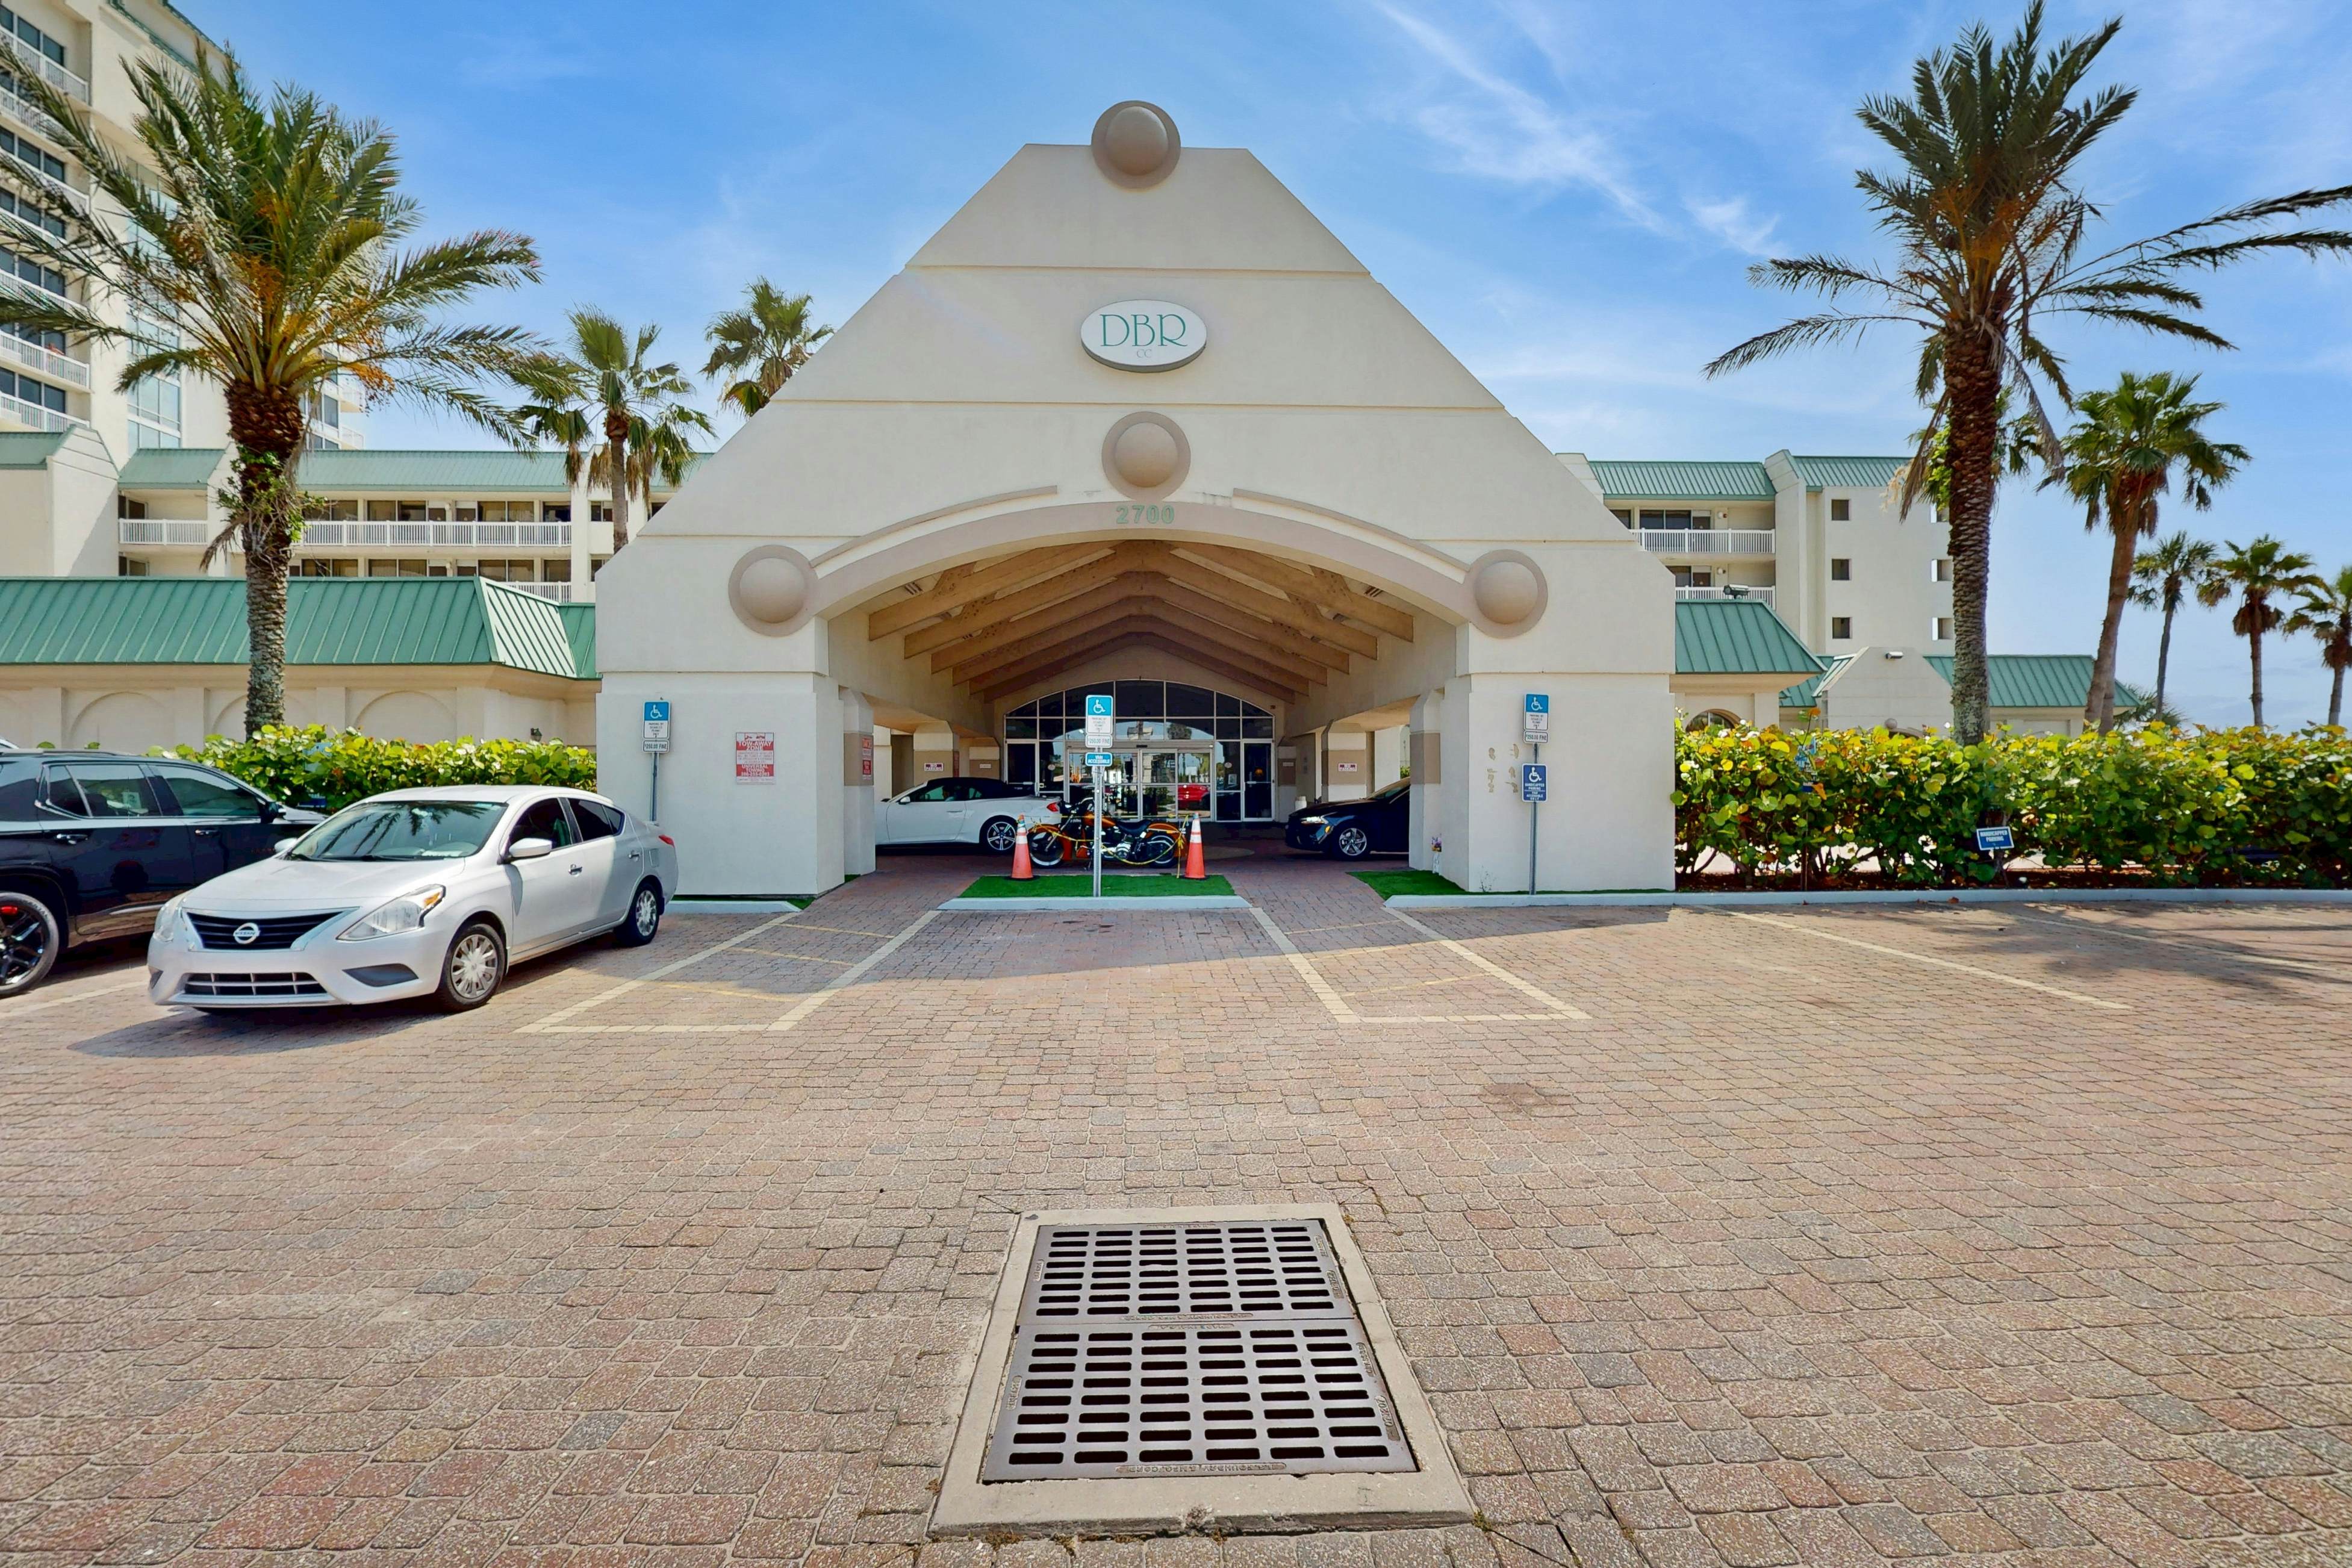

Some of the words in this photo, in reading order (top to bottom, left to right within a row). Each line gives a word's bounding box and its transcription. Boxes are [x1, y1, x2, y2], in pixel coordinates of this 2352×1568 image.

[1100, 314, 1188, 347] DBR
[1136, 349, 1153, 358] CC
[1116, 505, 1175, 524] 2700
